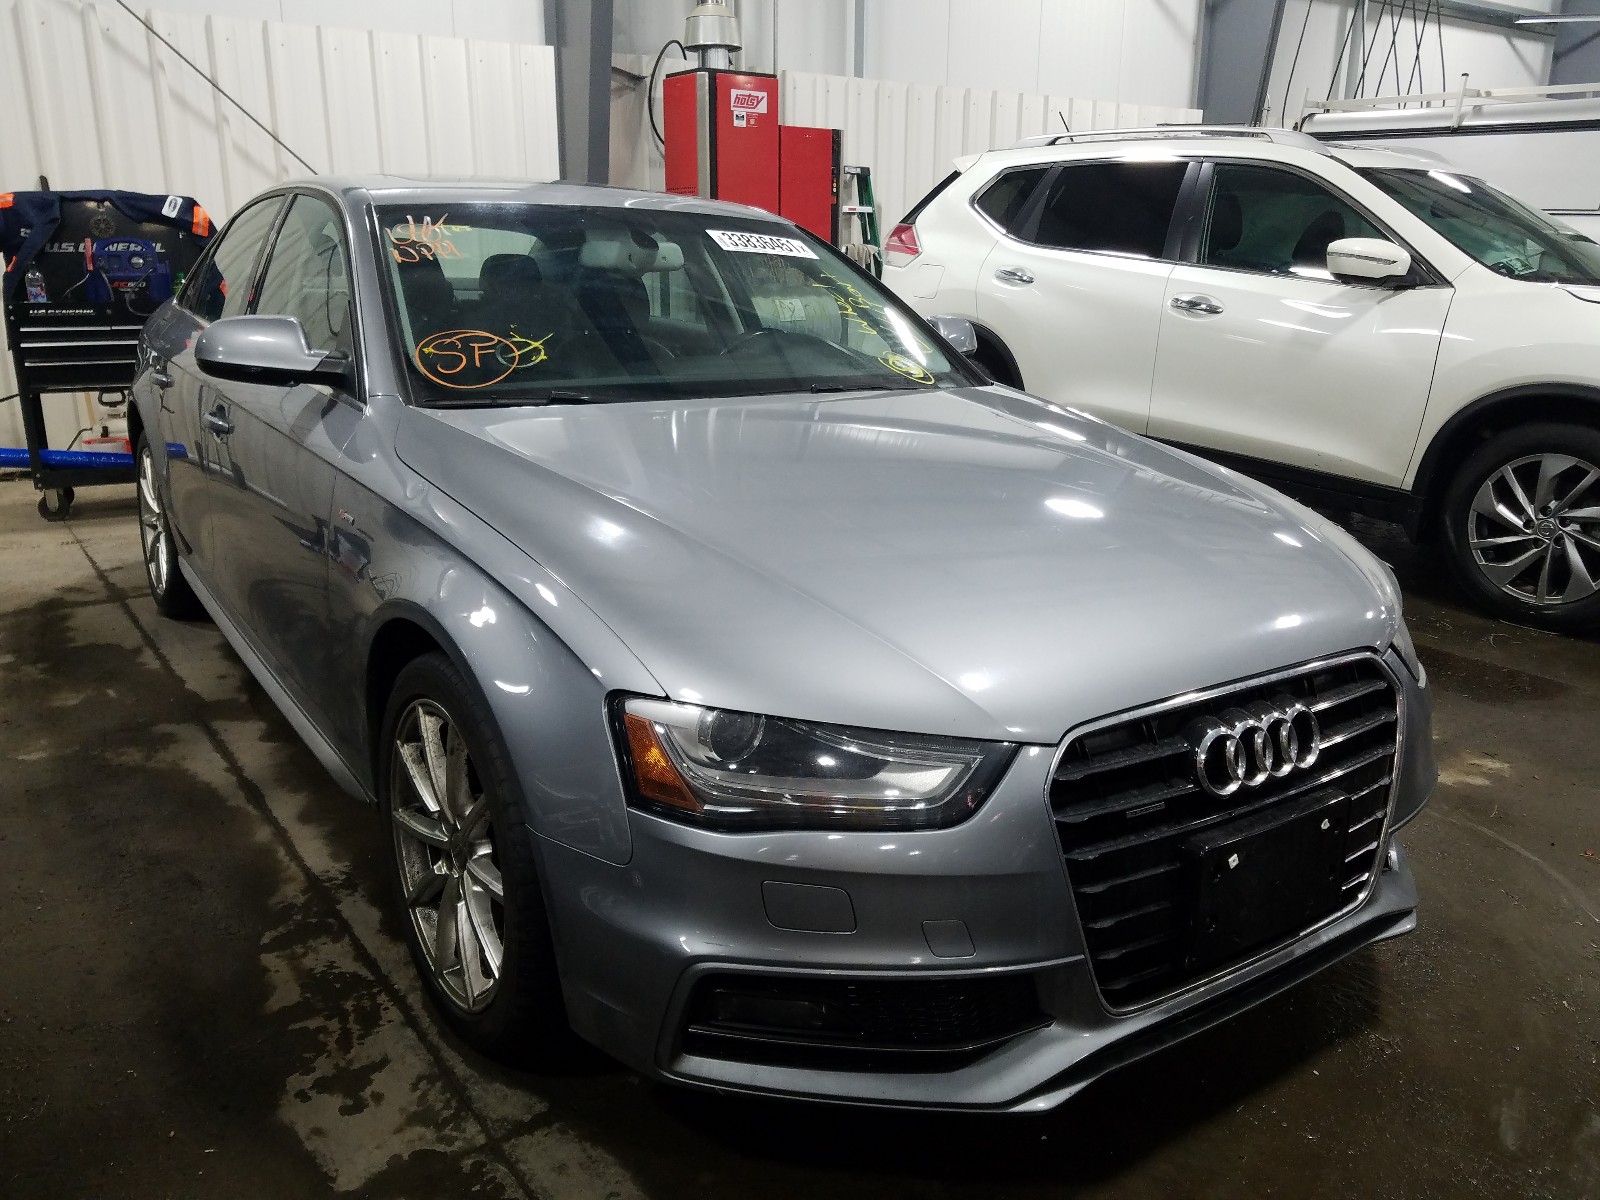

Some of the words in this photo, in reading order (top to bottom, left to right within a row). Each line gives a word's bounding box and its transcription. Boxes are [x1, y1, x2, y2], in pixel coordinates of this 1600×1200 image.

[733, 94, 765, 109] hotsy
[45, 243, 76, 253] U.S.
[79, 243, 166, 253] GNERL
[721, 233, 802, 254] 33836451
